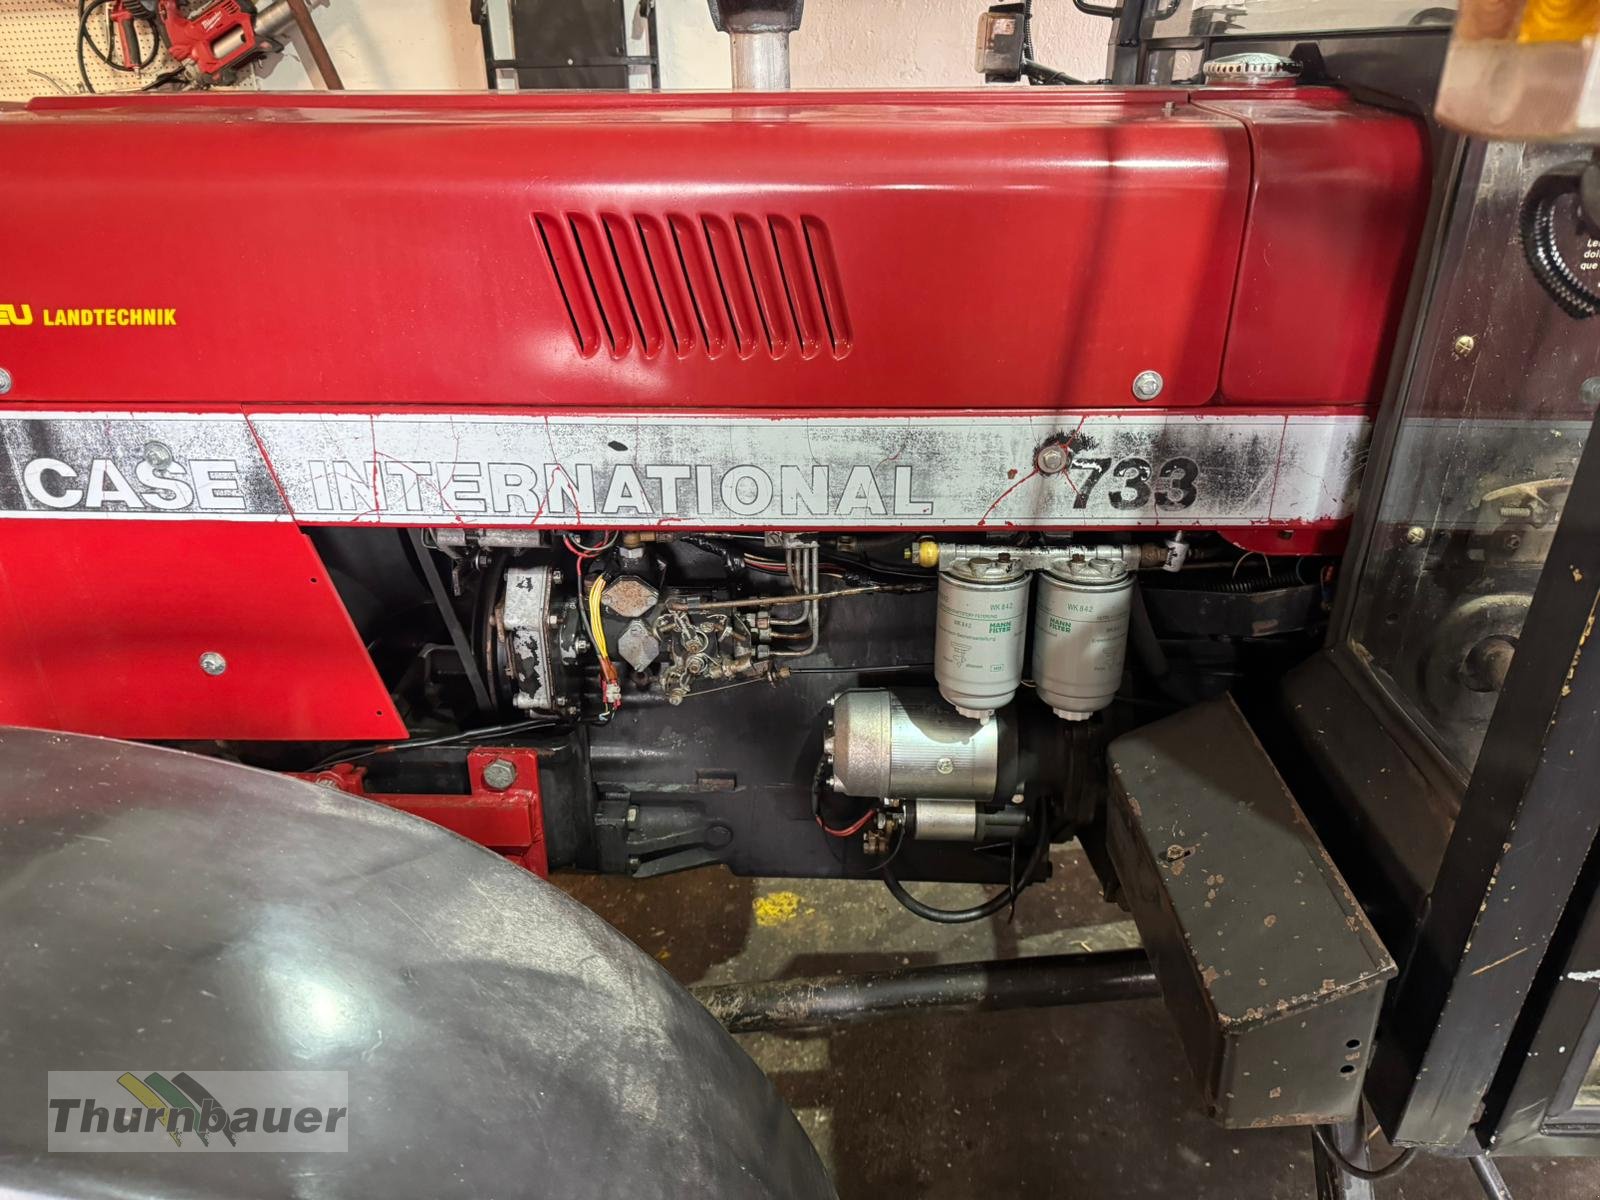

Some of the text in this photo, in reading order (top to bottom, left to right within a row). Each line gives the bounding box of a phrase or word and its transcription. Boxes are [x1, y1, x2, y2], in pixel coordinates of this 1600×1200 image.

[1580, 262, 1598, 271] que
[43, 308, 177, 326] LANDTECHNIK
[23, 456, 1199, 516] CASE INTERNATIONAL 733
[1067, 603, 1093, 613] WK 842
[1049, 617, 1071, 627] MANN
[1049, 623, 1071, 633] FILTER
